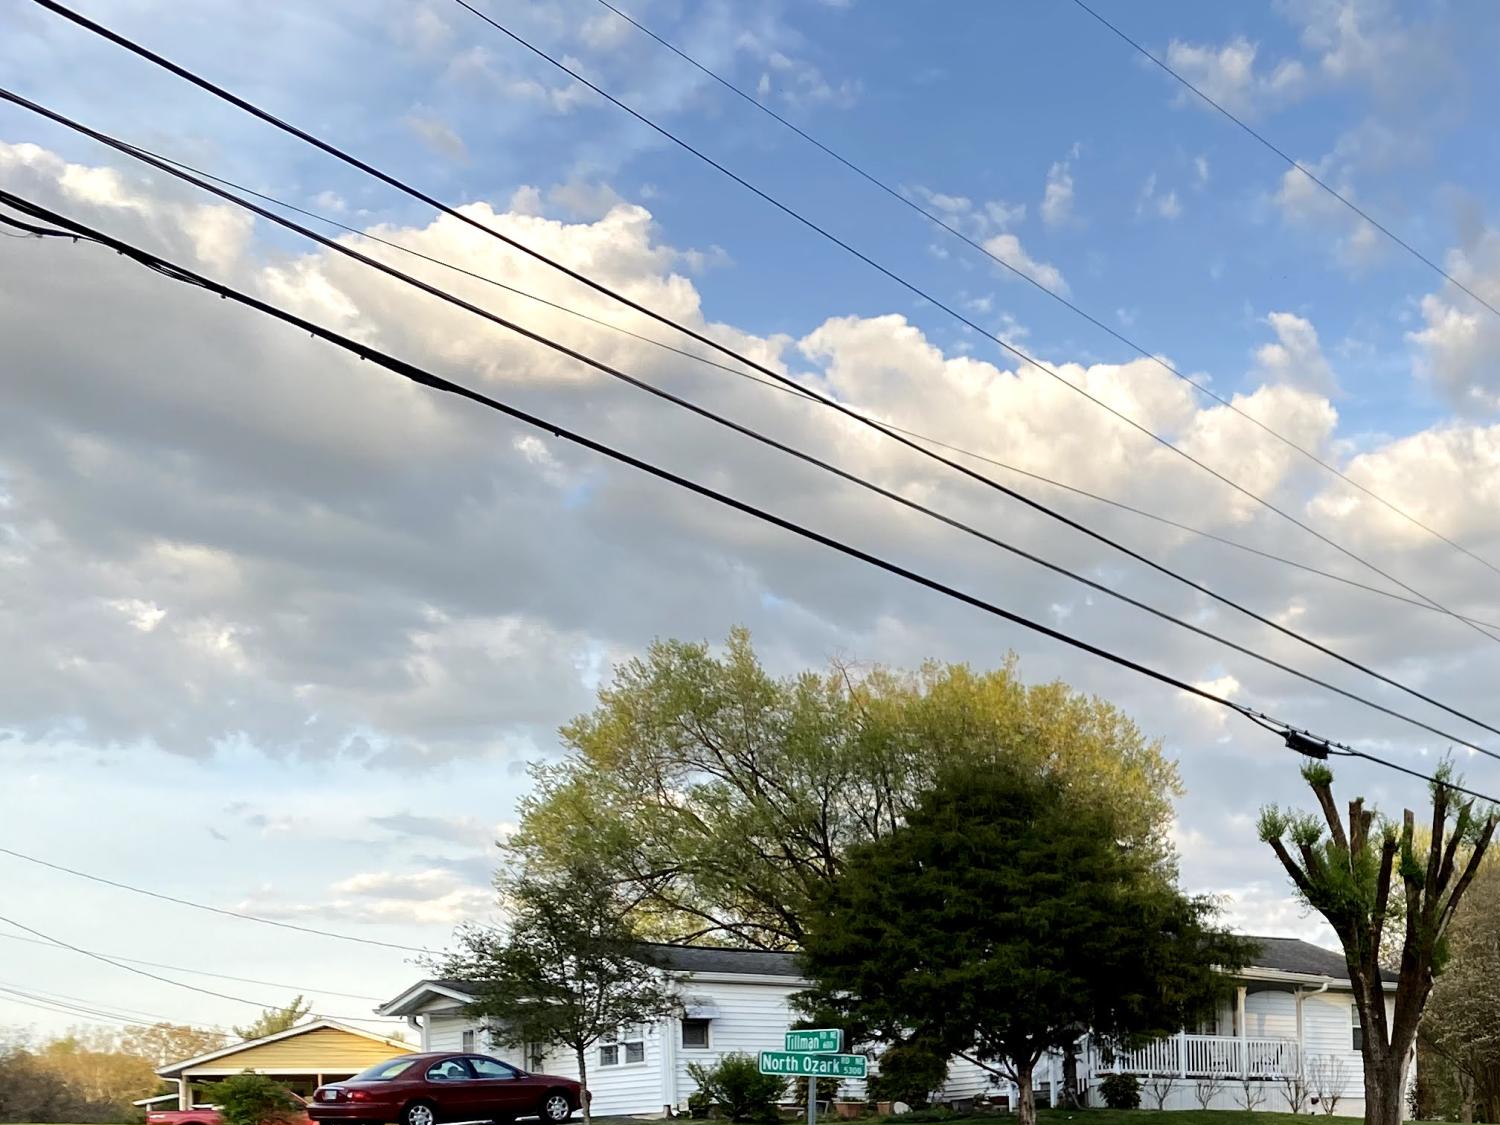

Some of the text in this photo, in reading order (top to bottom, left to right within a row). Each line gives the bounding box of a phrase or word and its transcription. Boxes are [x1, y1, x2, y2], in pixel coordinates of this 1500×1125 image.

[786, 1033, 819, 1050] Tillman
[762, 1054, 864, 1073] North Ozark RD NE
[843, 1066, 862, 1075] 5300
